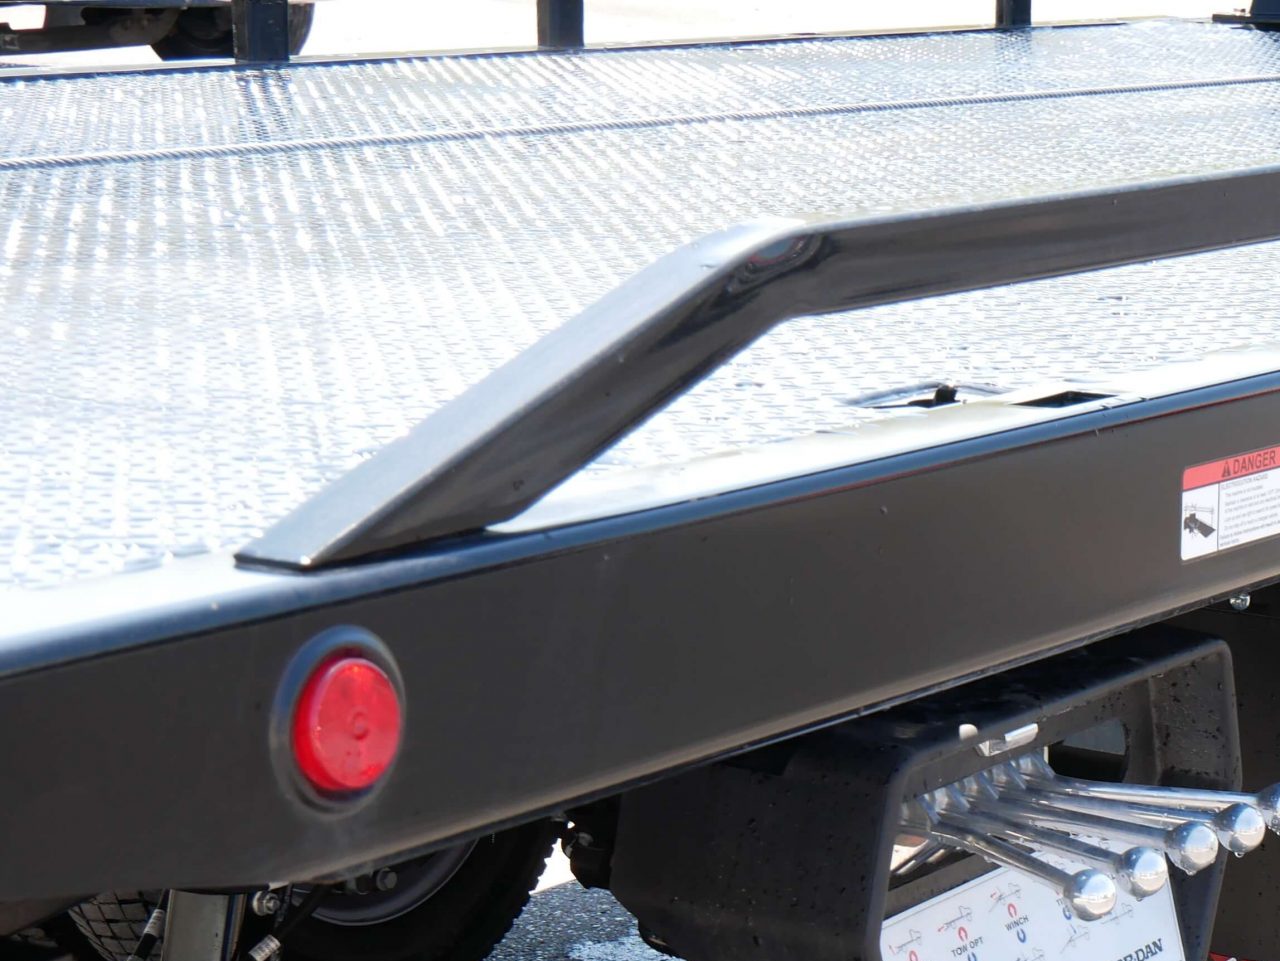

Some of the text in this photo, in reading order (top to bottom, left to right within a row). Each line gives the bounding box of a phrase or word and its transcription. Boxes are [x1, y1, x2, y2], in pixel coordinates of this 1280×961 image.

[1233, 449, 1277, 475] DANGER
[1005, 915, 1029, 931] WINCH
[951, 936, 984, 957] TOW OPT
